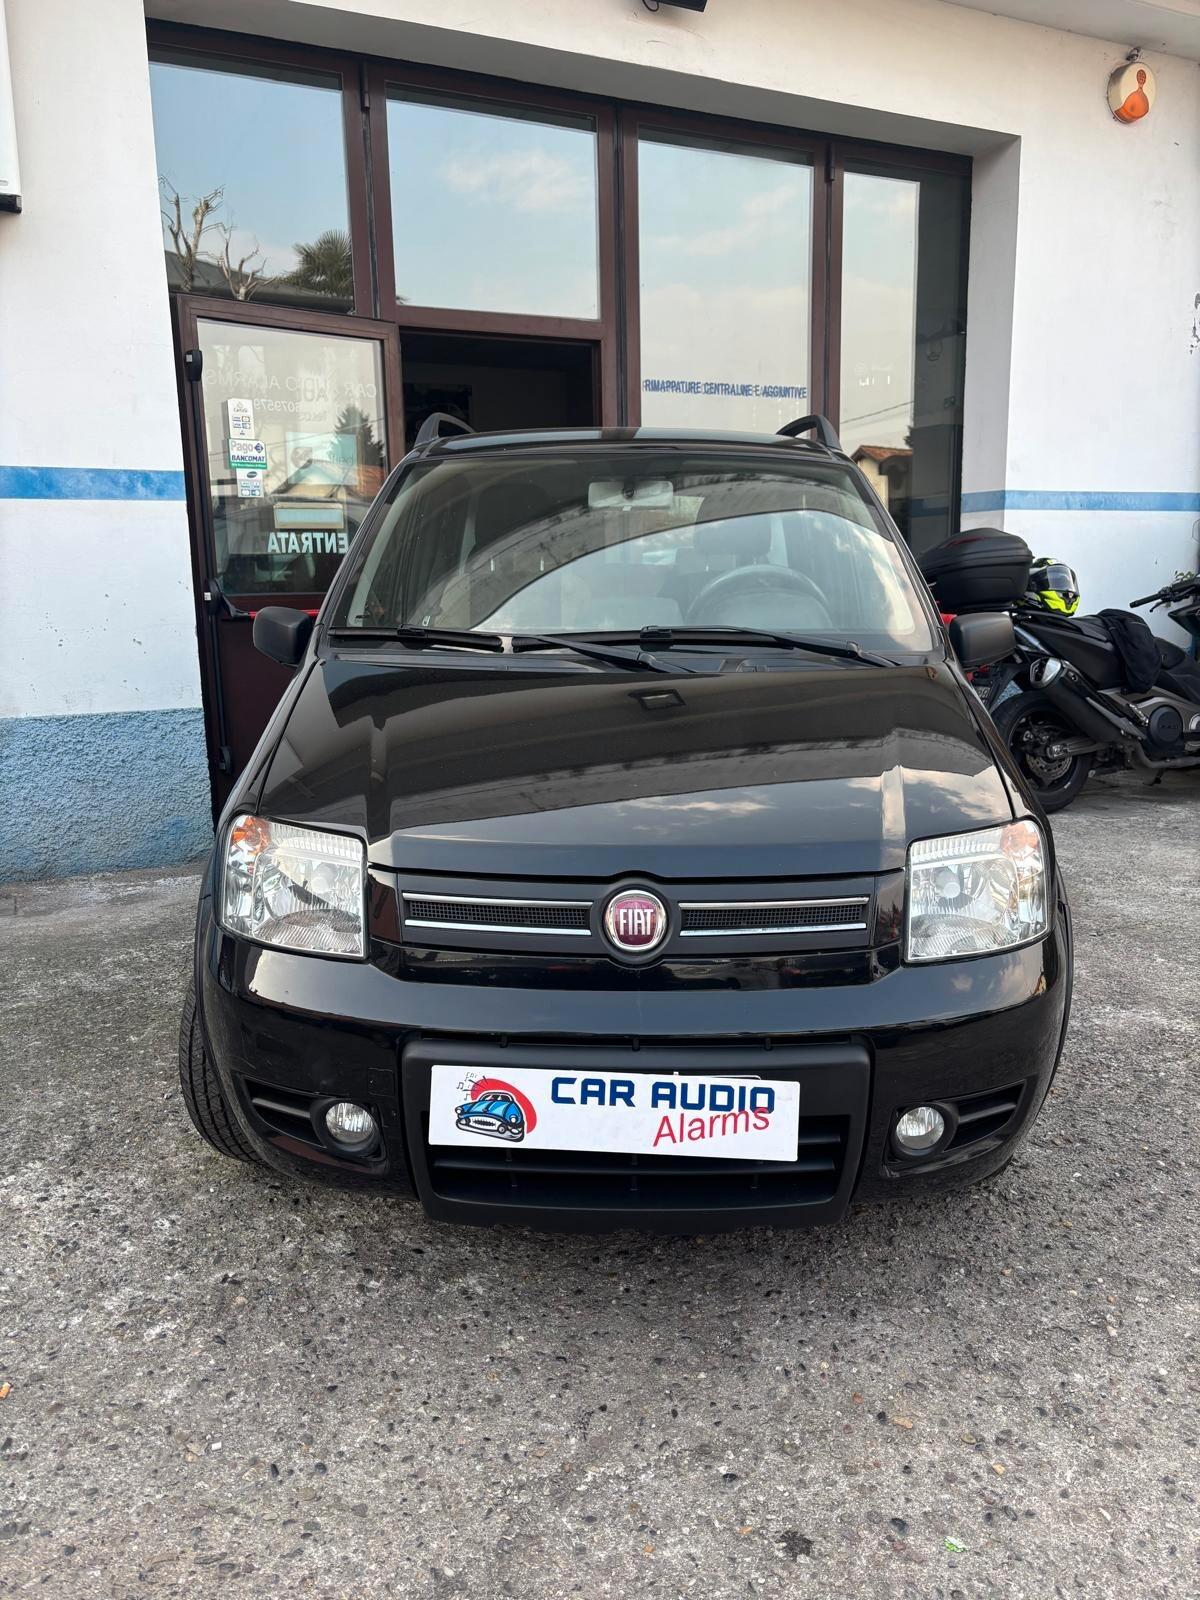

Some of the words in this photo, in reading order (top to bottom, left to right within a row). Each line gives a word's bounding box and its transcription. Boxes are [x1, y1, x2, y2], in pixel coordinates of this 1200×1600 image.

[643, 379, 701, 394] RIMAPPATURE
[703, 382, 752, 397] CENTRALINE
[761, 385, 807, 399] AGGIUNTIVE
[231, 441, 253, 454] Pago
[620, 908, 653, 935] FIAT
[551, 1077, 635, 1107] CAR
[651, 1082, 775, 1113] AUDIO
[653, 1107, 770, 1147] Alarms
